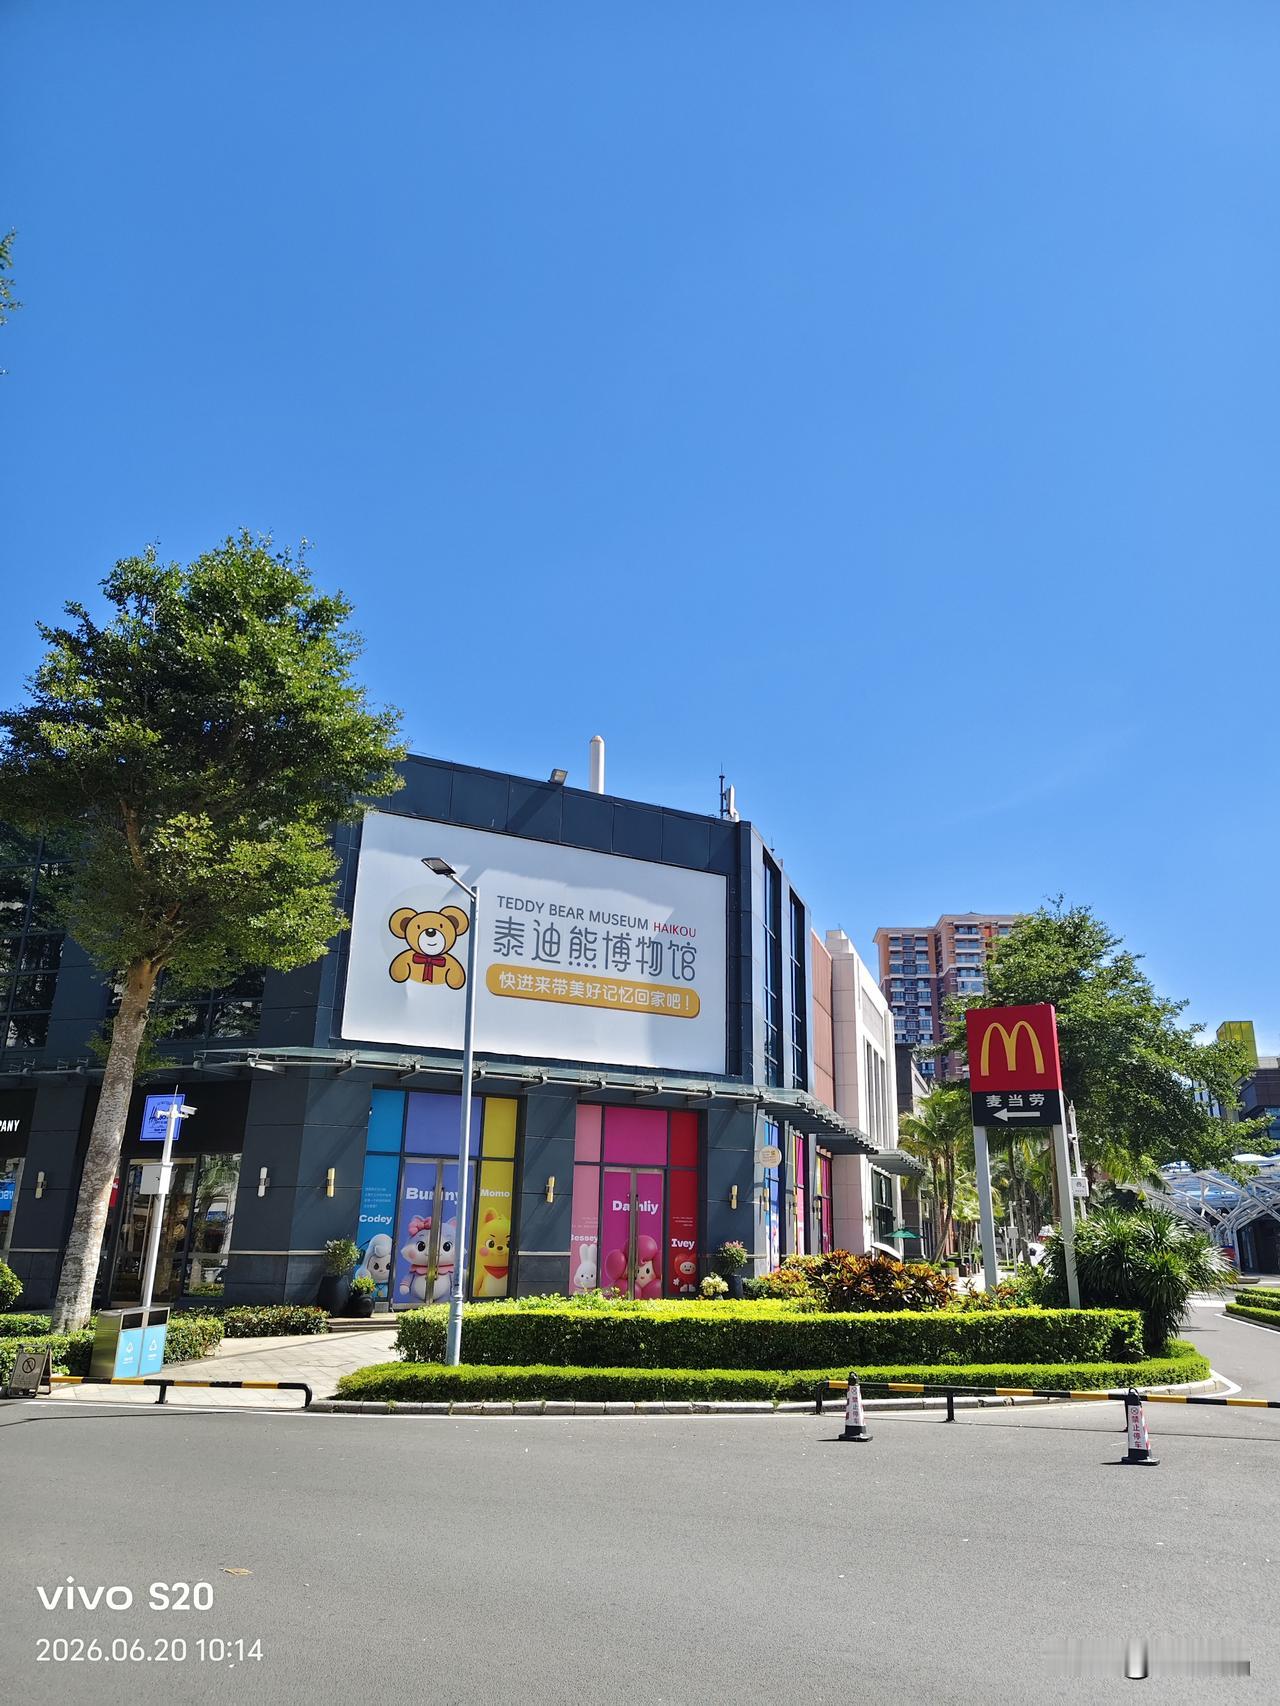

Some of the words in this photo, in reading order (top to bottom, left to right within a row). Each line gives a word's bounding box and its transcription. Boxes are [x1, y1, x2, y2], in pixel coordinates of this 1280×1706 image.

[497, 895, 544, 915] TEDDY
[549, 902, 584, 921] BEAR
[589, 910, 648, 931] MUSEUM
[653, 921, 696, 938] HAIKOU
[493, 916, 697, 982] 泰迪熊博物馆
[986, 1094, 1045, 1107] 麦当劳
[480, 1188, 511, 1198] Momo
[359, 1214, 392, 1225] Codey
[671, 1238, 695, 1250] Ivey
[1132, 1415, 1142, 1448] 禁止停车
